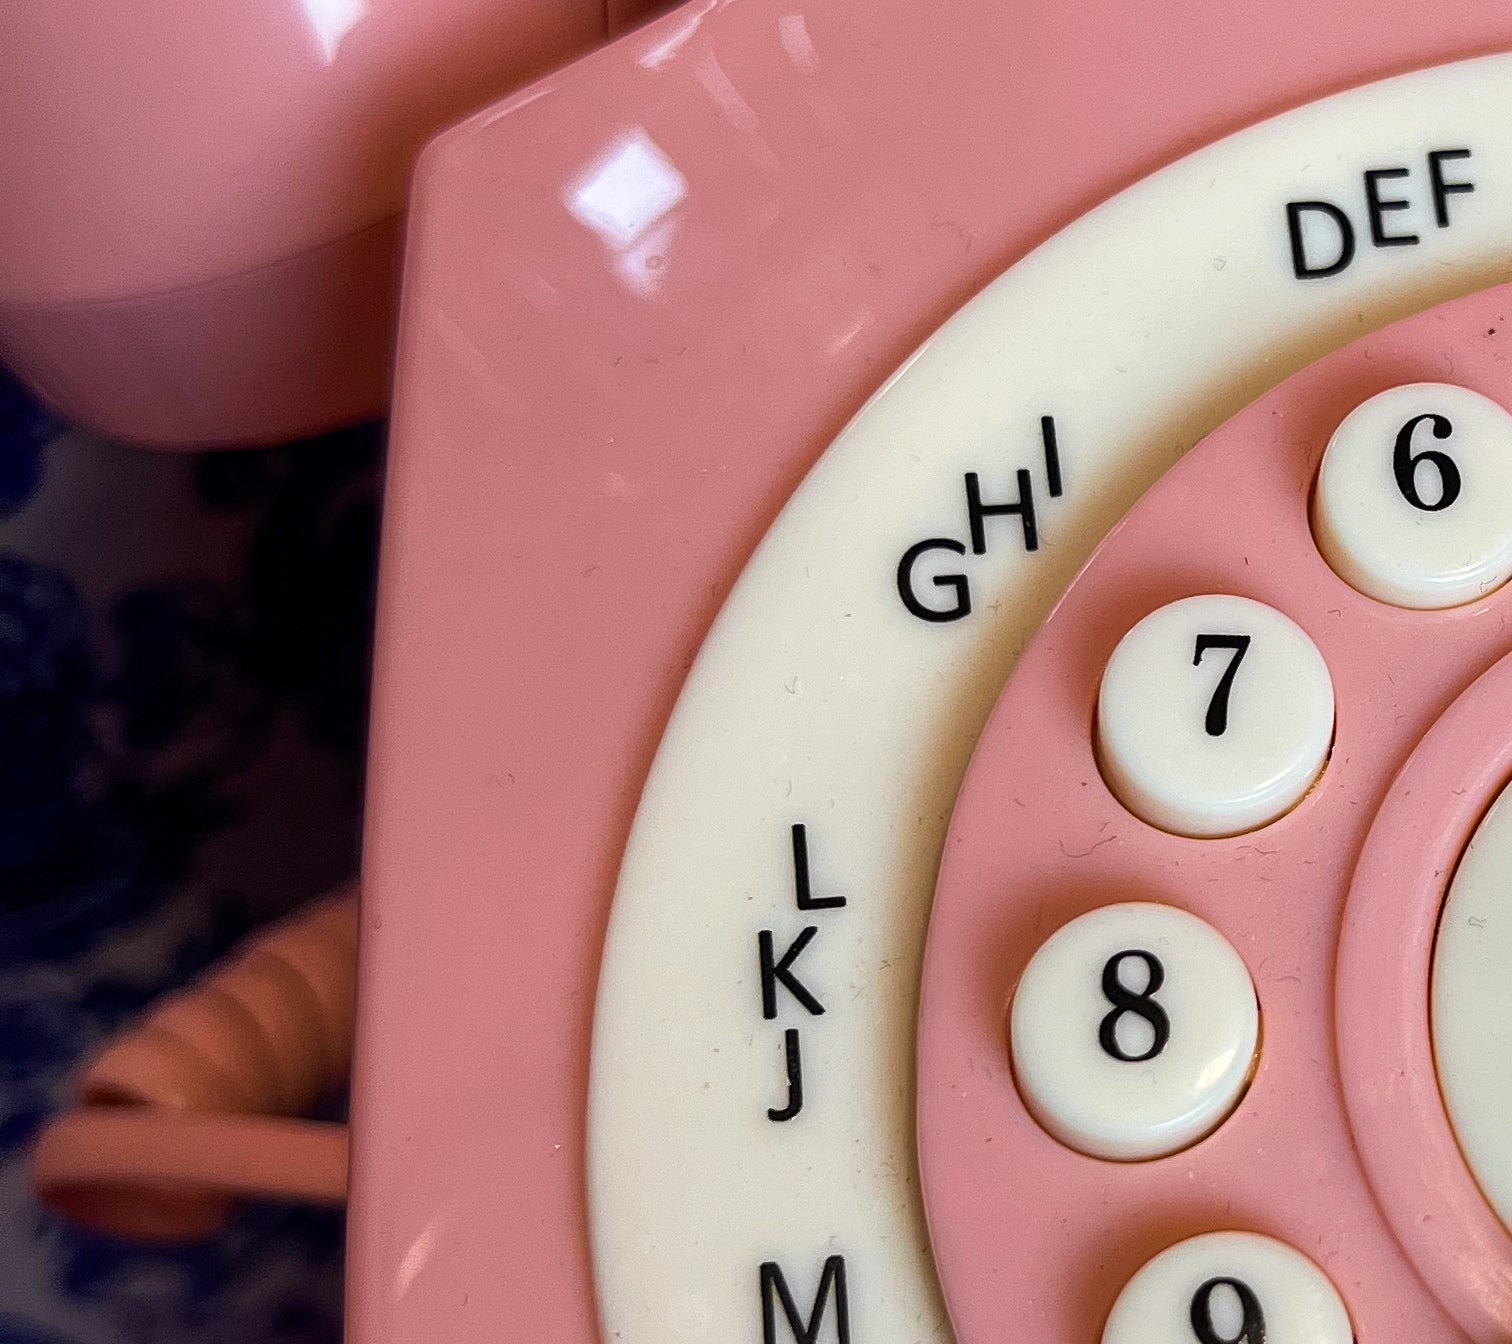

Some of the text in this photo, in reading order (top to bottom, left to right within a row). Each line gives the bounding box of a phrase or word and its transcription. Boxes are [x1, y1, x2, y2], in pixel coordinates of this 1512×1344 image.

[1286, 149, 1474, 280] DEF
[1393, 414, 1461, 511] 6
[897, 416, 1064, 623] GHI
[1193, 634, 1250, 736] 7
[1098, 950, 1170, 1062] 8
